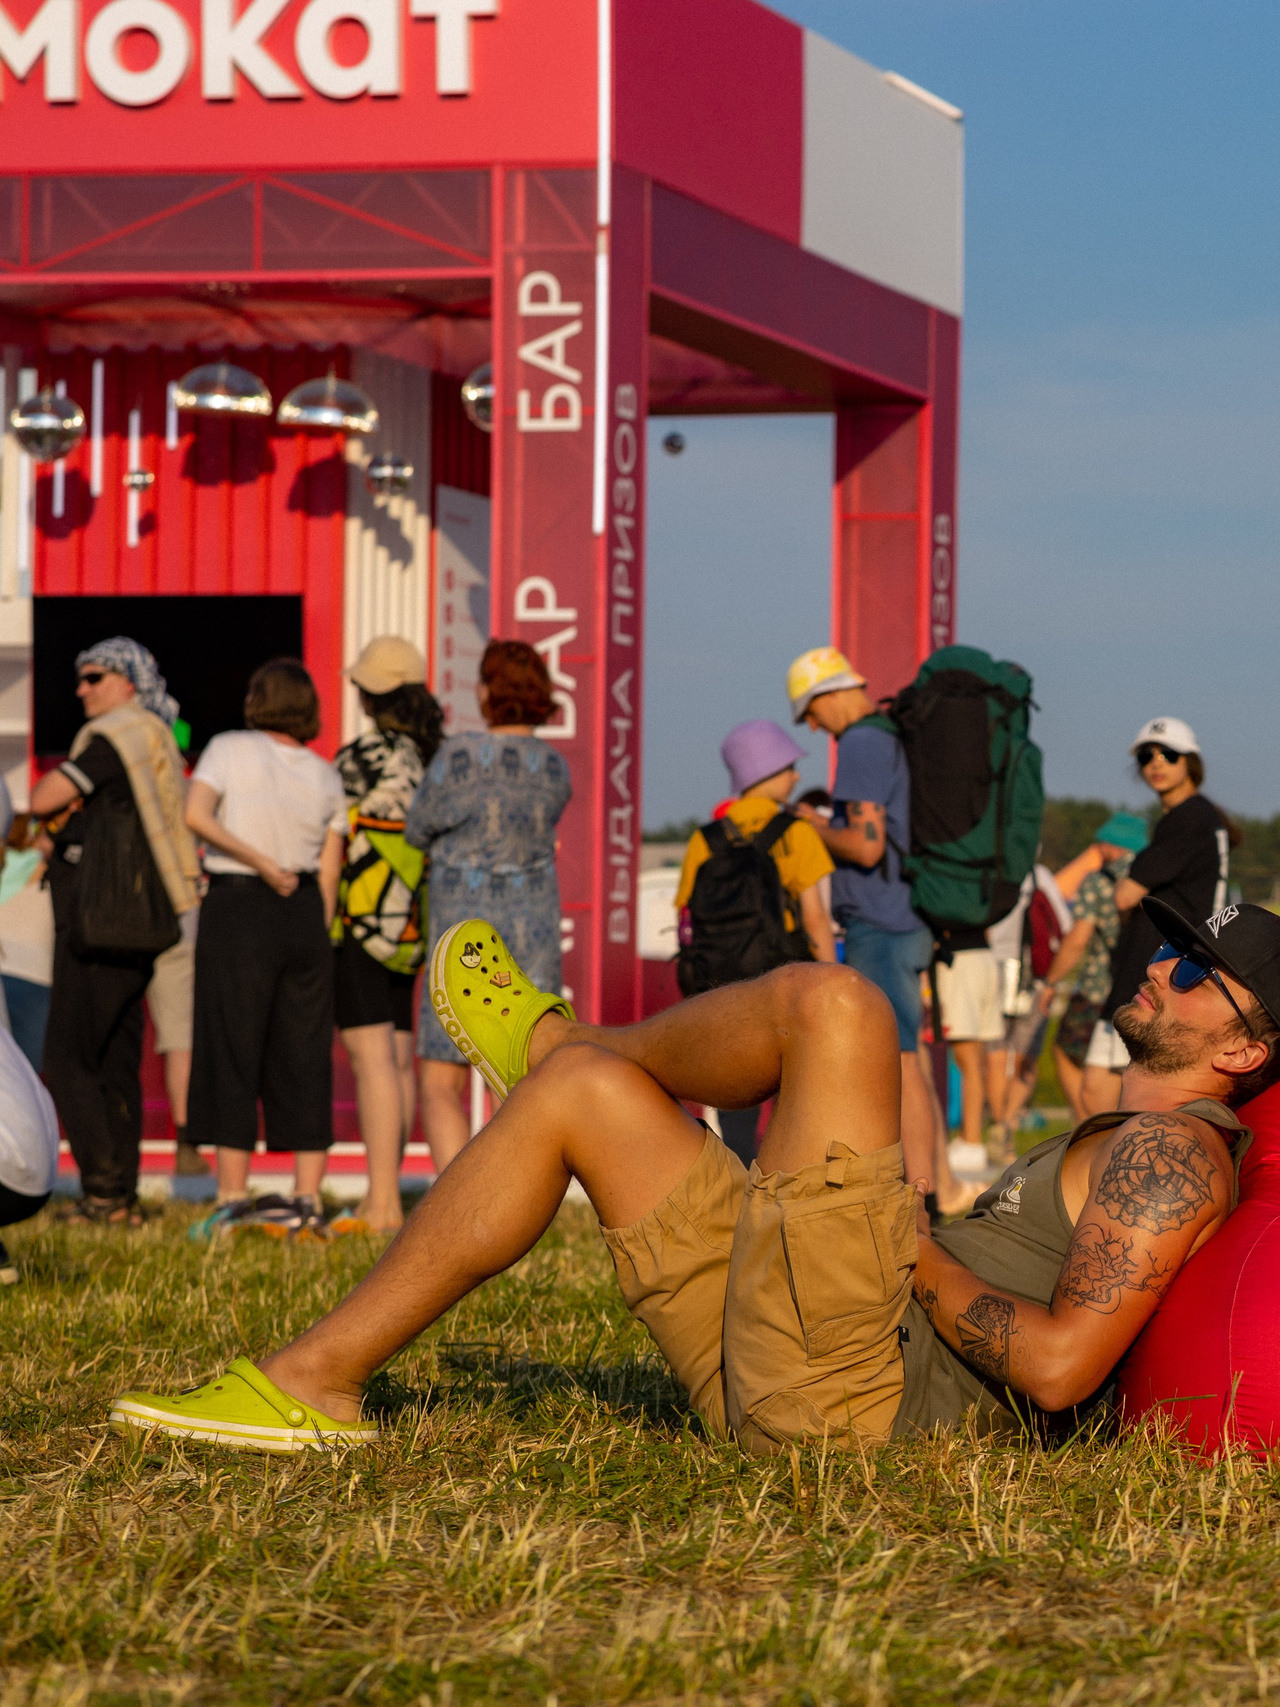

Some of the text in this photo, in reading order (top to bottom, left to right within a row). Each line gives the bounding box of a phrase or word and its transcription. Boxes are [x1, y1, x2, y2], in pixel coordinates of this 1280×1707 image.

[517, 270, 583, 432] БАР
[608, 383, 638, 944] ВЫДАЧА ПРИЗОВ
[432, 989, 484, 1066] crocs
